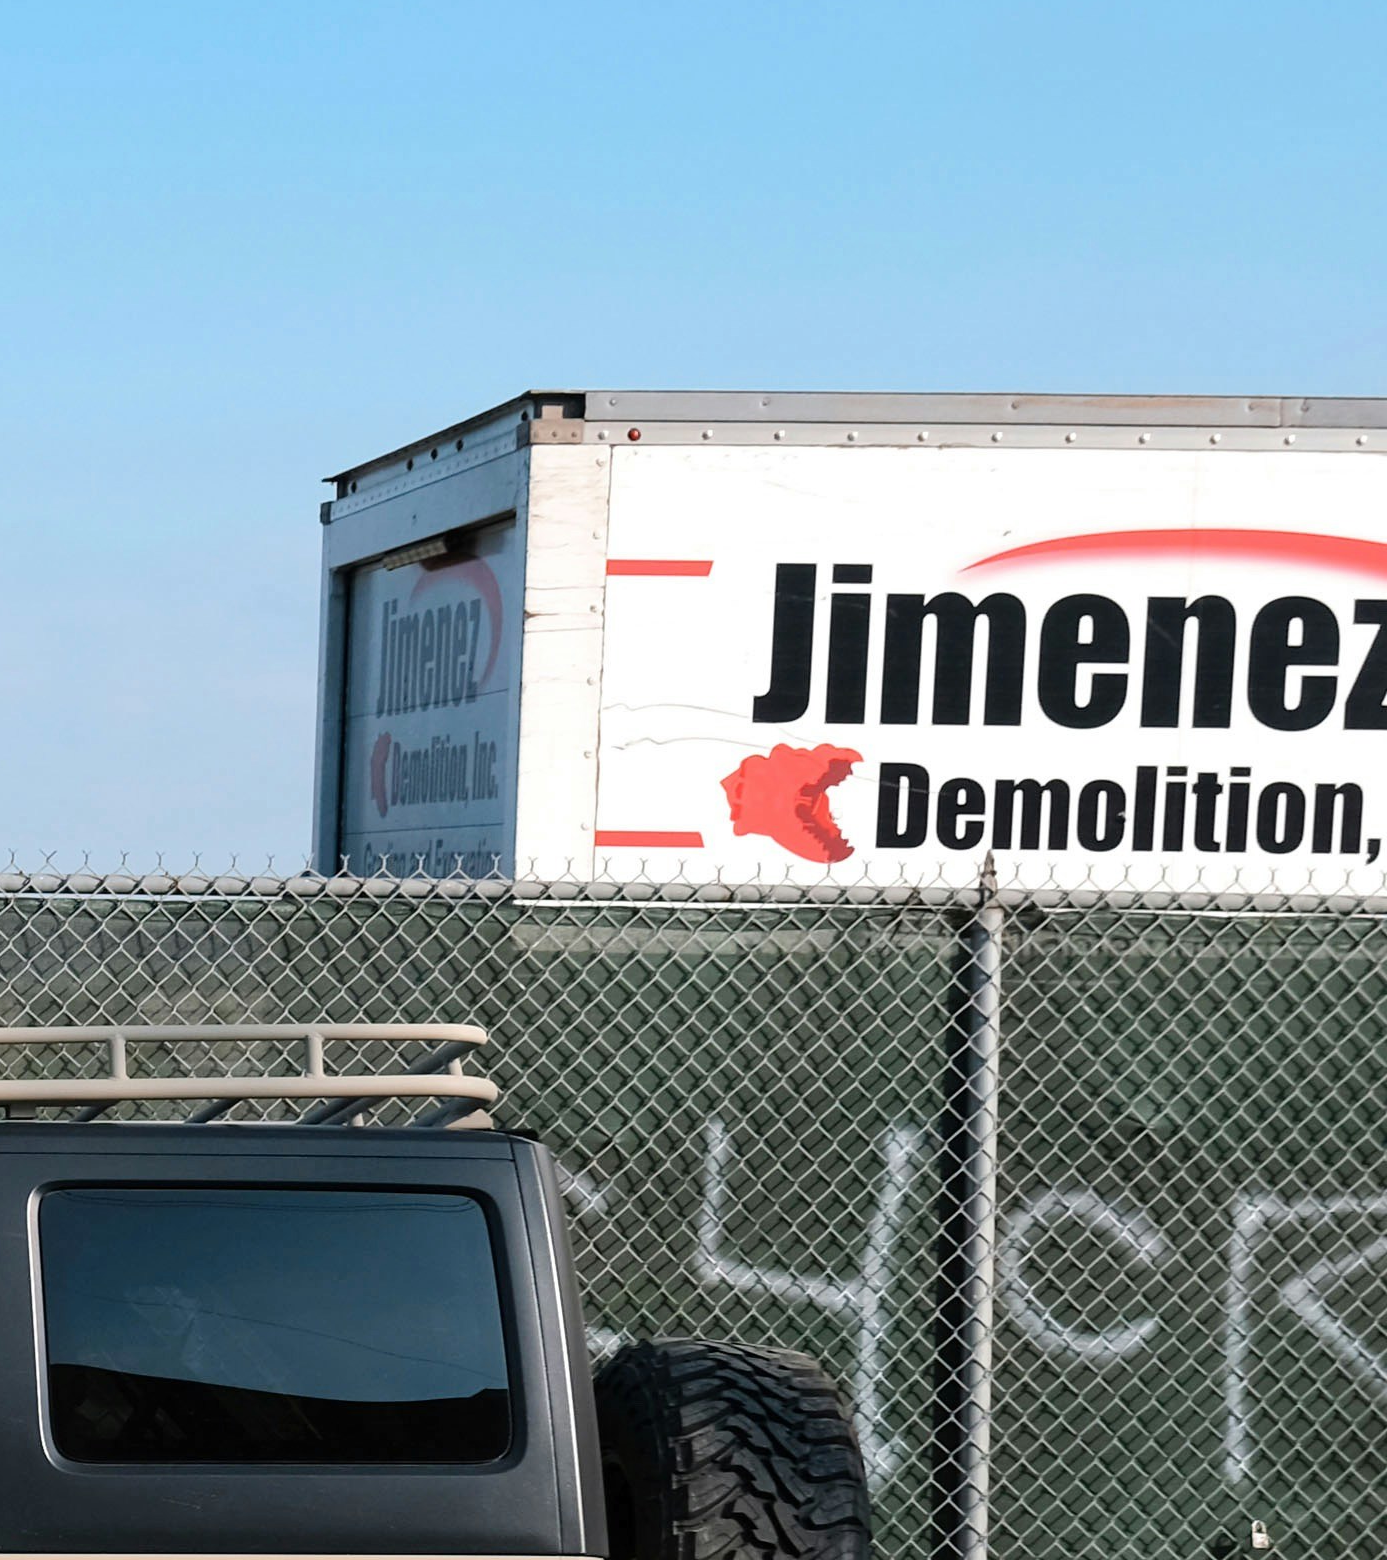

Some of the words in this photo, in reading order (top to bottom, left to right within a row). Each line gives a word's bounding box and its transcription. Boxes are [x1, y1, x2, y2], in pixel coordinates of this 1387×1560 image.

[376, 598, 482, 720] Jimenez
[752, 561, 1387, 732] Jimenez
[390, 735, 469, 808] Demolition,
[473, 731, 499, 801] Inc.
[875, 761, 1382, 865] Demolition,
